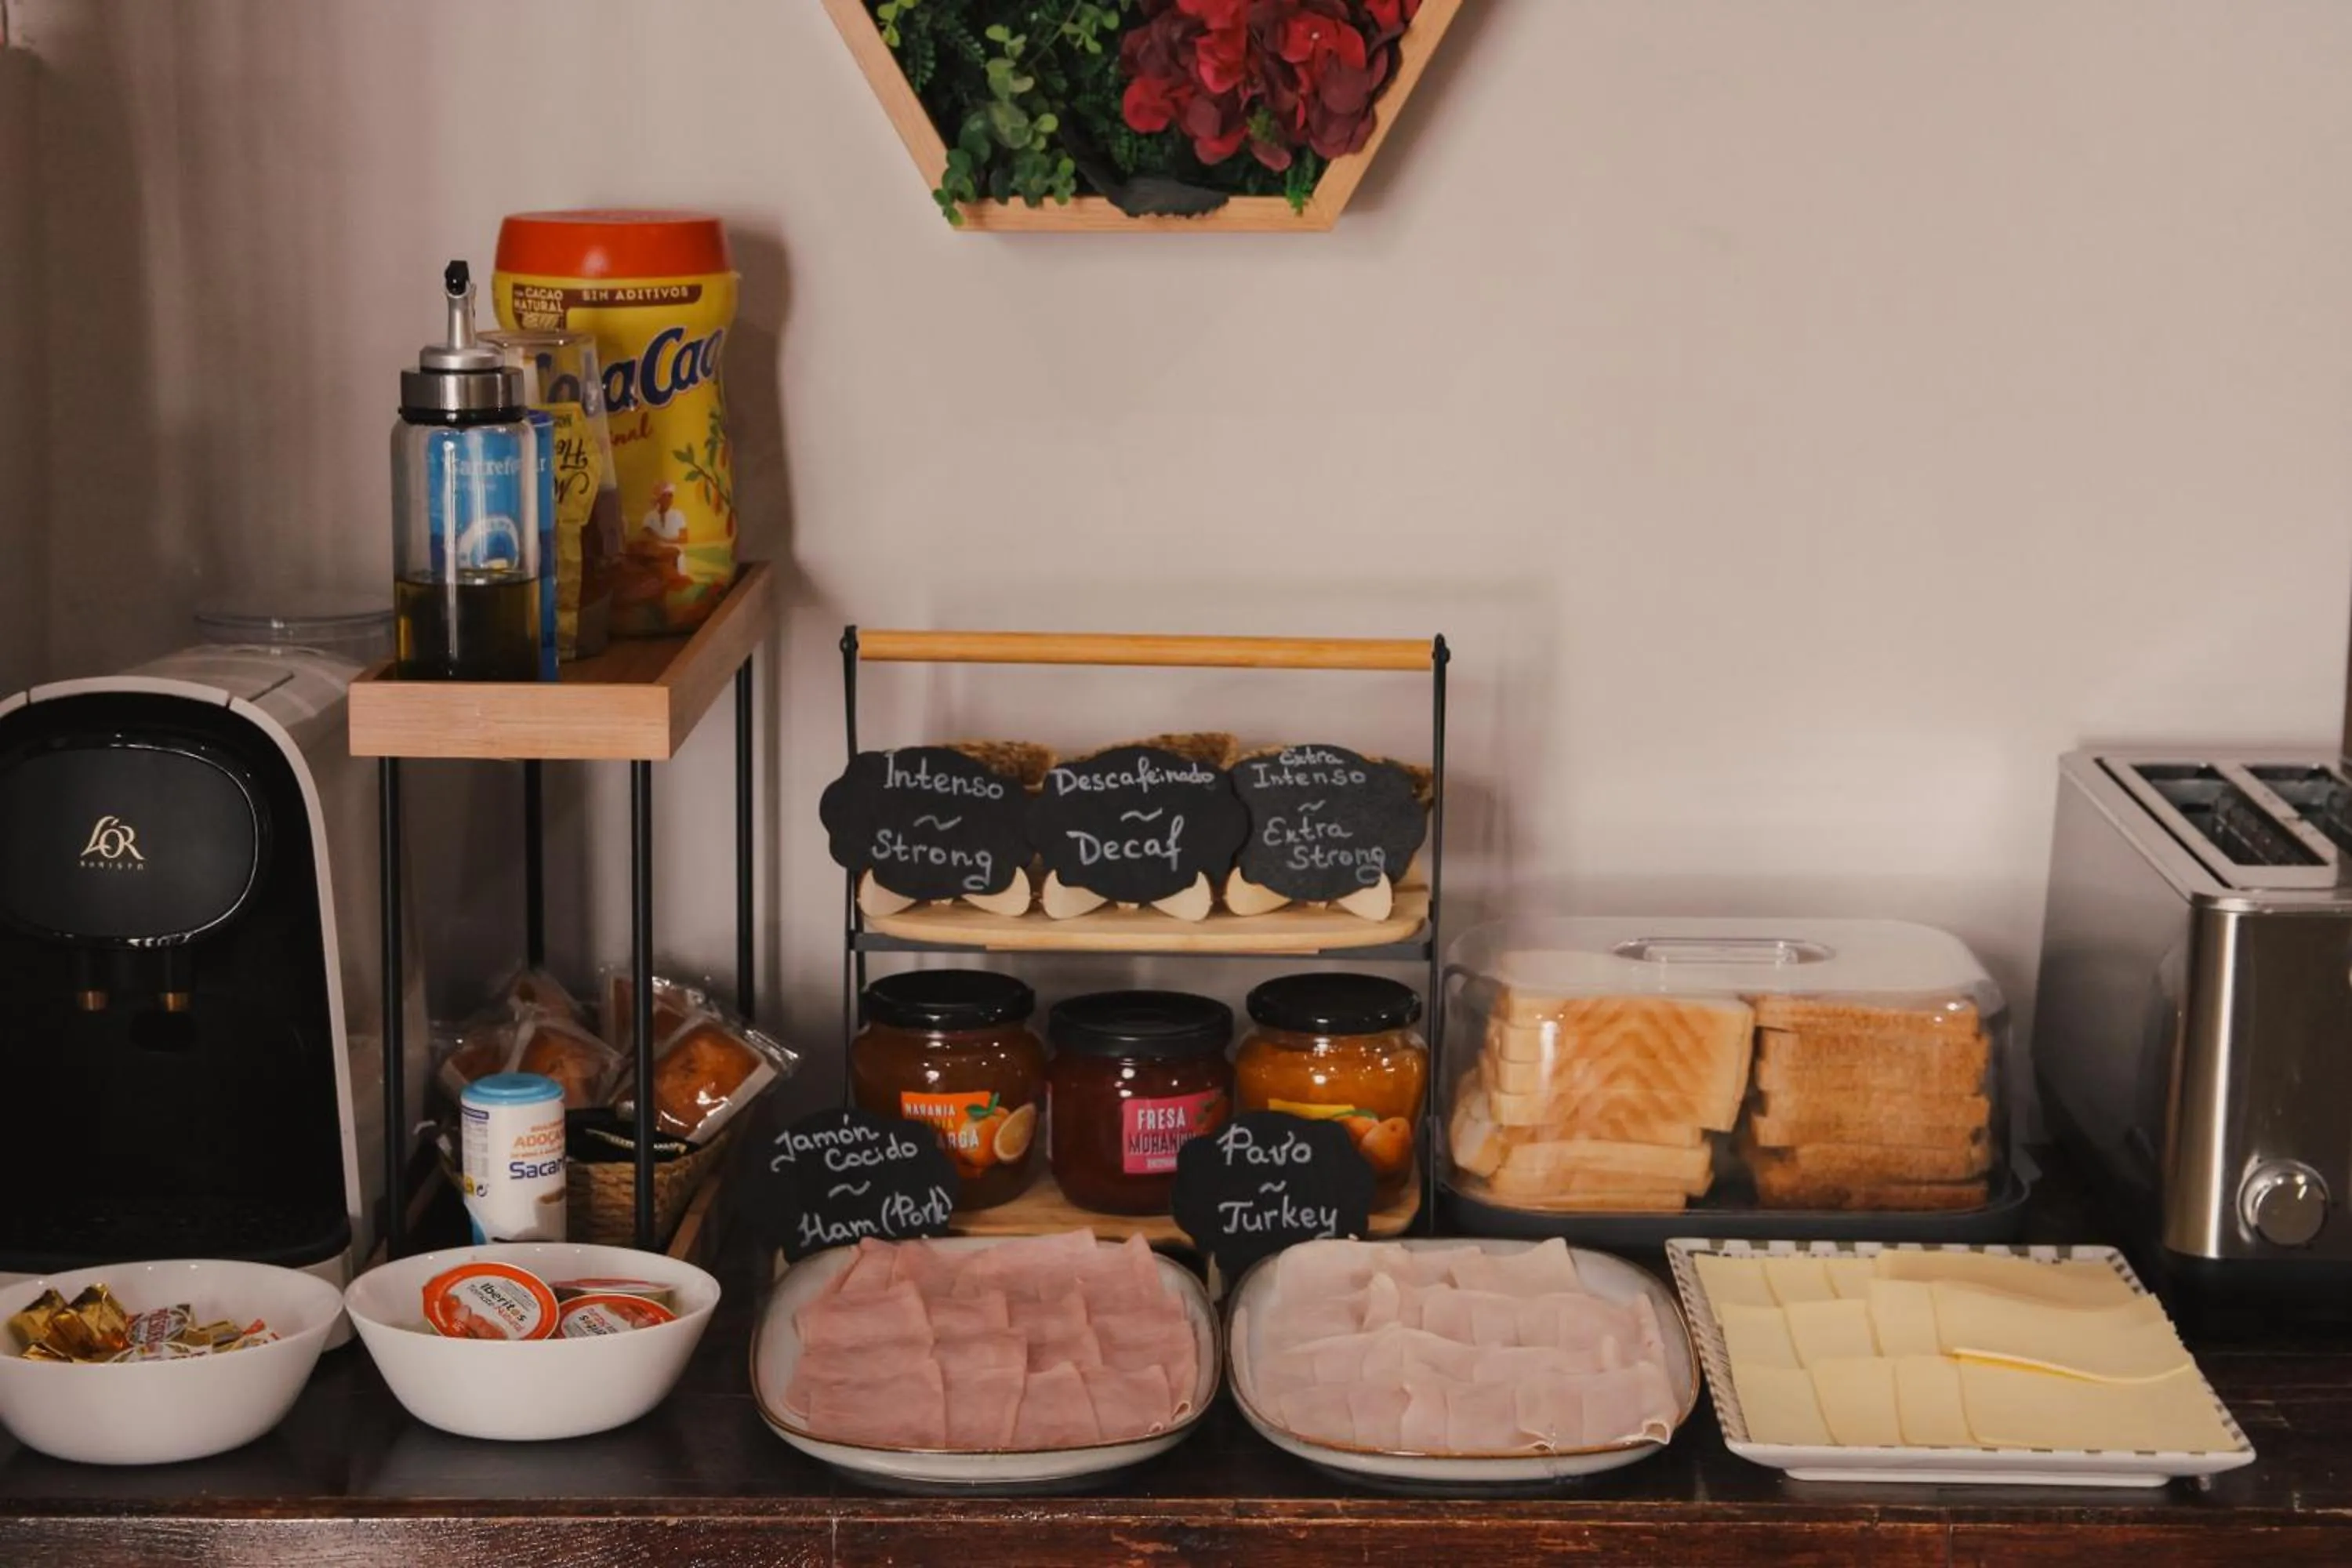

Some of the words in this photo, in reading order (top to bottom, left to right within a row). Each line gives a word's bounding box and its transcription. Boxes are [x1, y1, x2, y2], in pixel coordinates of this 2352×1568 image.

[514, 298, 564, 313] NATURAL
[525, 287, 563, 301] CACAO
[582, 289, 608, 301] SIN
[615, 285, 688, 301] ADITIVOS
[883, 753, 1004, 799] Intenso
[1049, 756, 1215, 796] Descafeinado
[1250, 763, 1367, 789] Intenso
[1279, 746, 1345, 767] Extra
[1066, 815, 1185, 872] Decaf
[1263, 816, 1354, 846] Extra
[872, 828, 992, 891] Strong
[1286, 844, 1385, 884] Strong
[1138, 1106, 1185, 1131] FRESA
[771, 1113, 880, 1172] Jamón
[826, 1133, 918, 1171] Cocido
[1216, 1123, 1312, 1166] Pavo
[797, 1212, 879, 1247] Ham
[882, 1185, 953, 1236] (Pork)
[1218, 1195, 1338, 1239] Turkey
[480, 1282, 527, 1321] Iberitos
